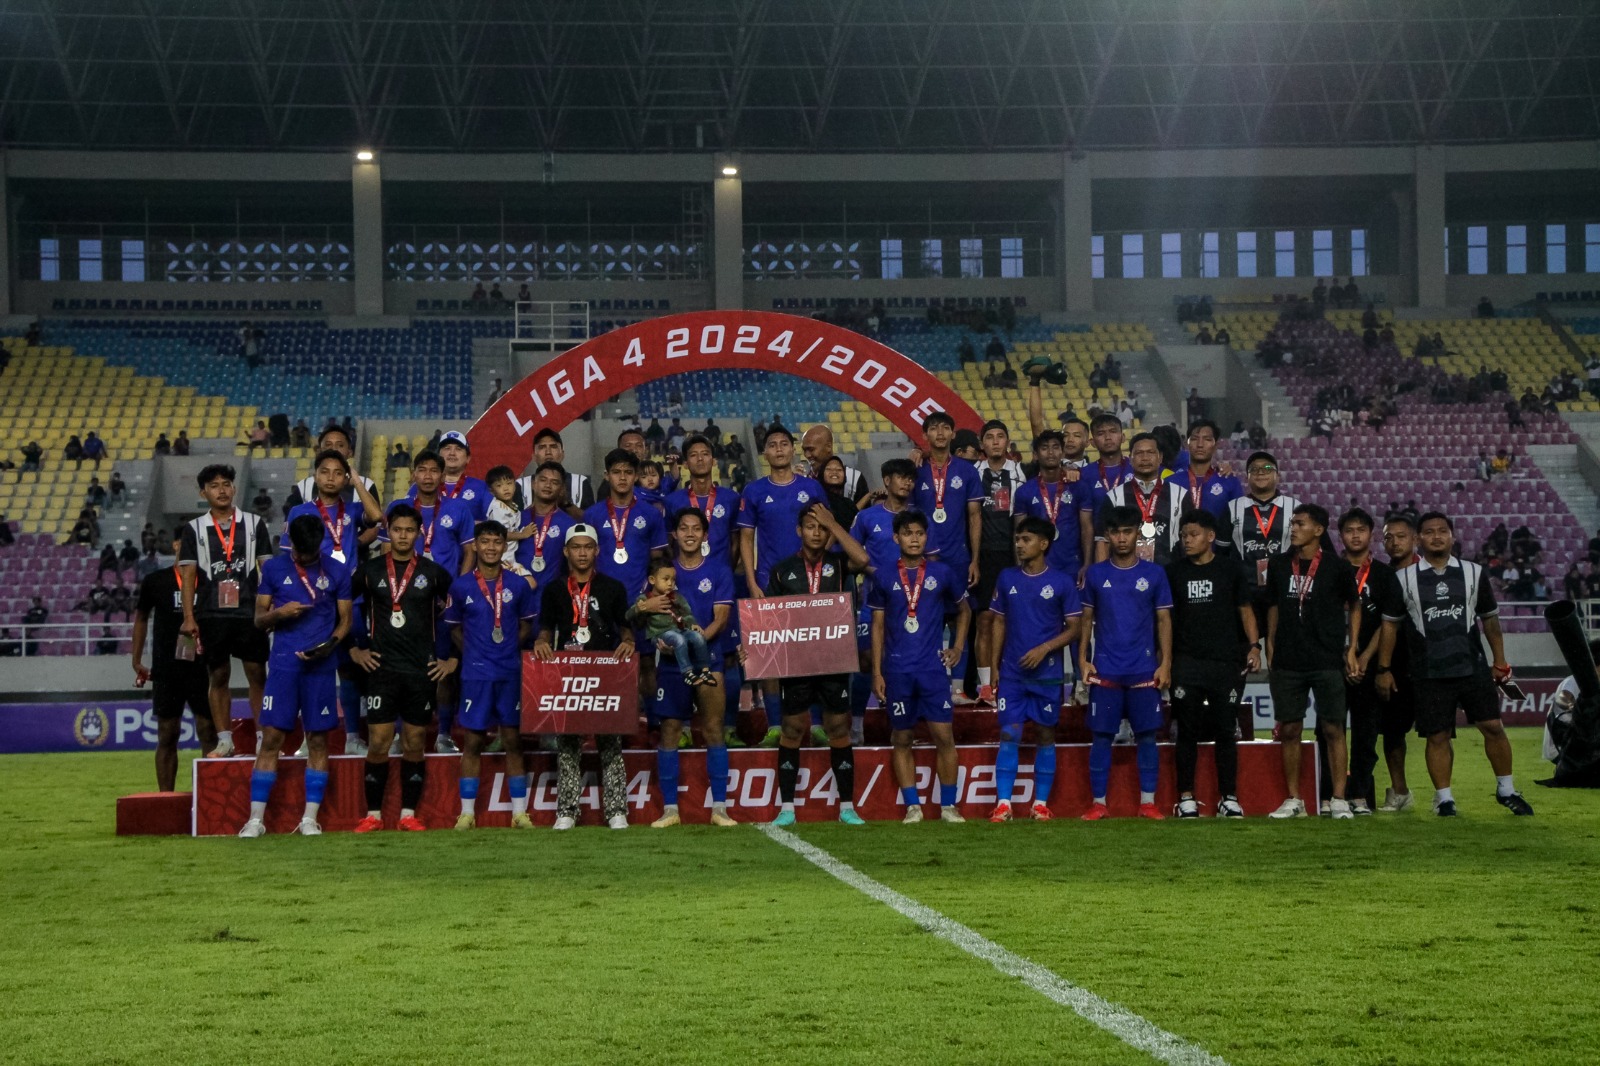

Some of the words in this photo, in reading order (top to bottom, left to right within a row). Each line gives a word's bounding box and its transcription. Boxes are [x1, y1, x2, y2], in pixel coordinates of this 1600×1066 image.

[506, 356, 606, 437] LIGA
[622, 337, 646, 367] 4
[665, 324, 946, 427] 2024/2025
[758, 603, 776, 611] LIGA
[785, 601, 806, 609] 2024
[748, 626, 821, 645] RUNNER
[825, 624, 849, 640] UP
[562, 656, 568, 664] 4
[570, 656, 591, 664] 2024
[561, 676, 600, 693] TOP
[657, 688, 664, 701] 9
[262, 695, 273, 711] 91
[367, 695, 382, 710] 90
[465, 699, 472, 713] 7
[538, 695, 621, 712] SCORER
[892, 701, 906, 716] 21
[626, 770, 651, 809] 4
